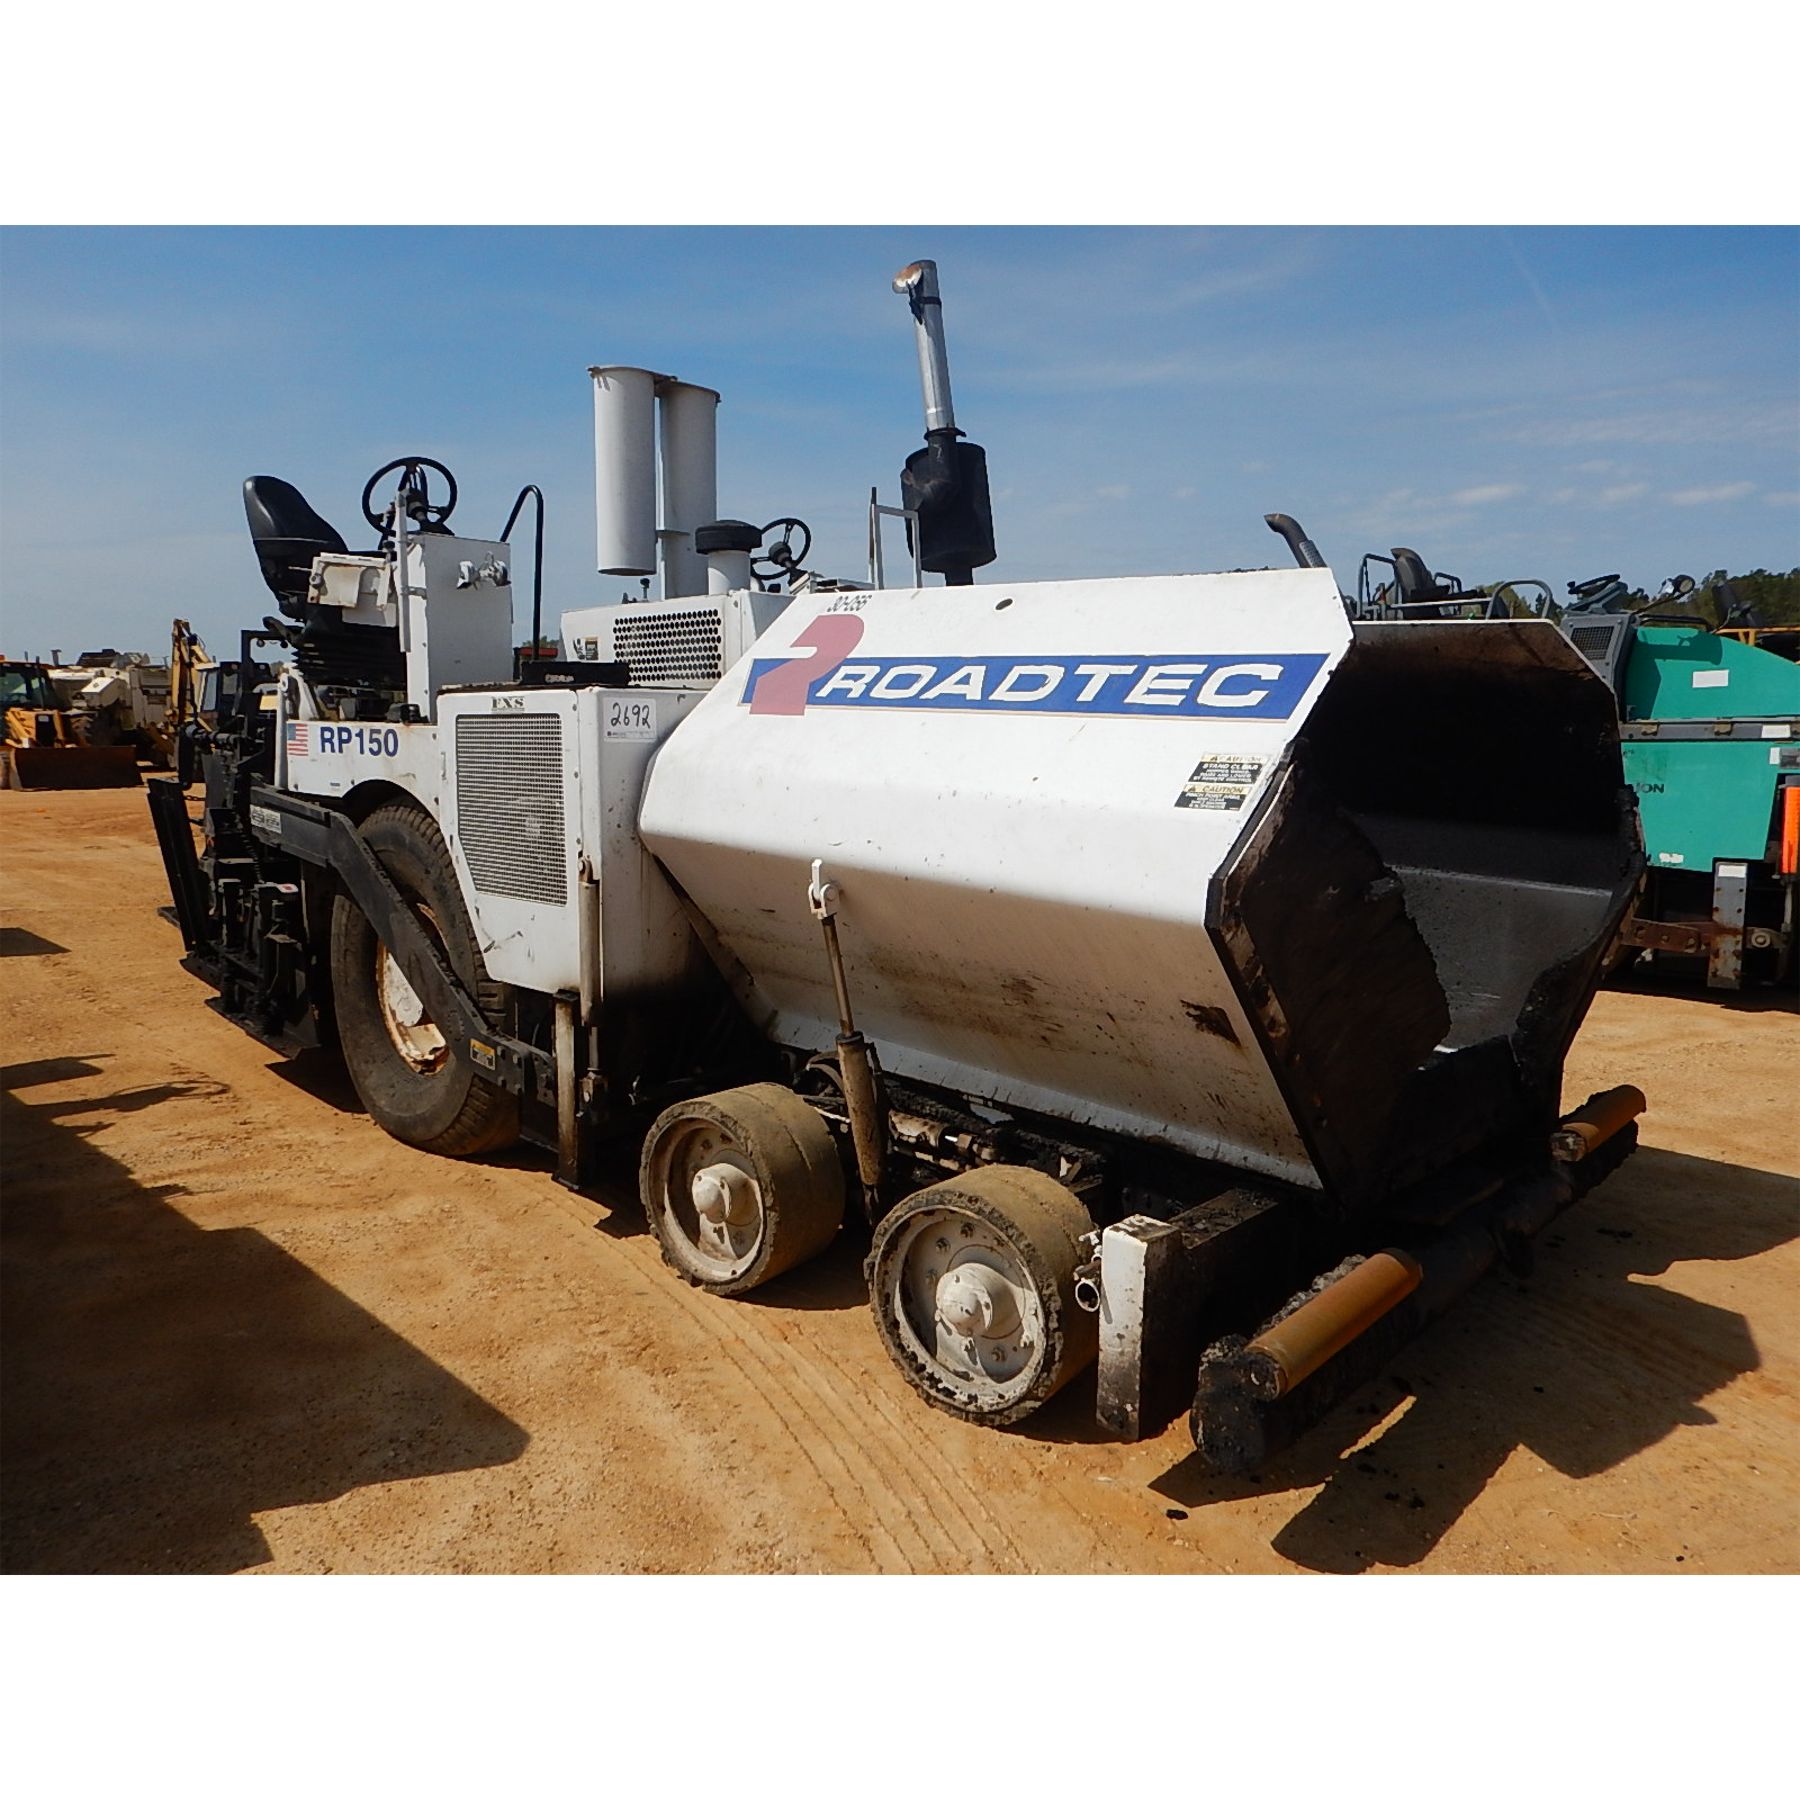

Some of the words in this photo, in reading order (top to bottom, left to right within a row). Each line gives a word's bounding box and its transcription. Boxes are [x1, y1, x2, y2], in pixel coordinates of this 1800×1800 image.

[815, 663, 1285, 708] ROADTEC
[610, 701, 651, 729] 2692
[320, 726, 399, 757] RP150
[1202, 785, 1244, 794] CAUTION
